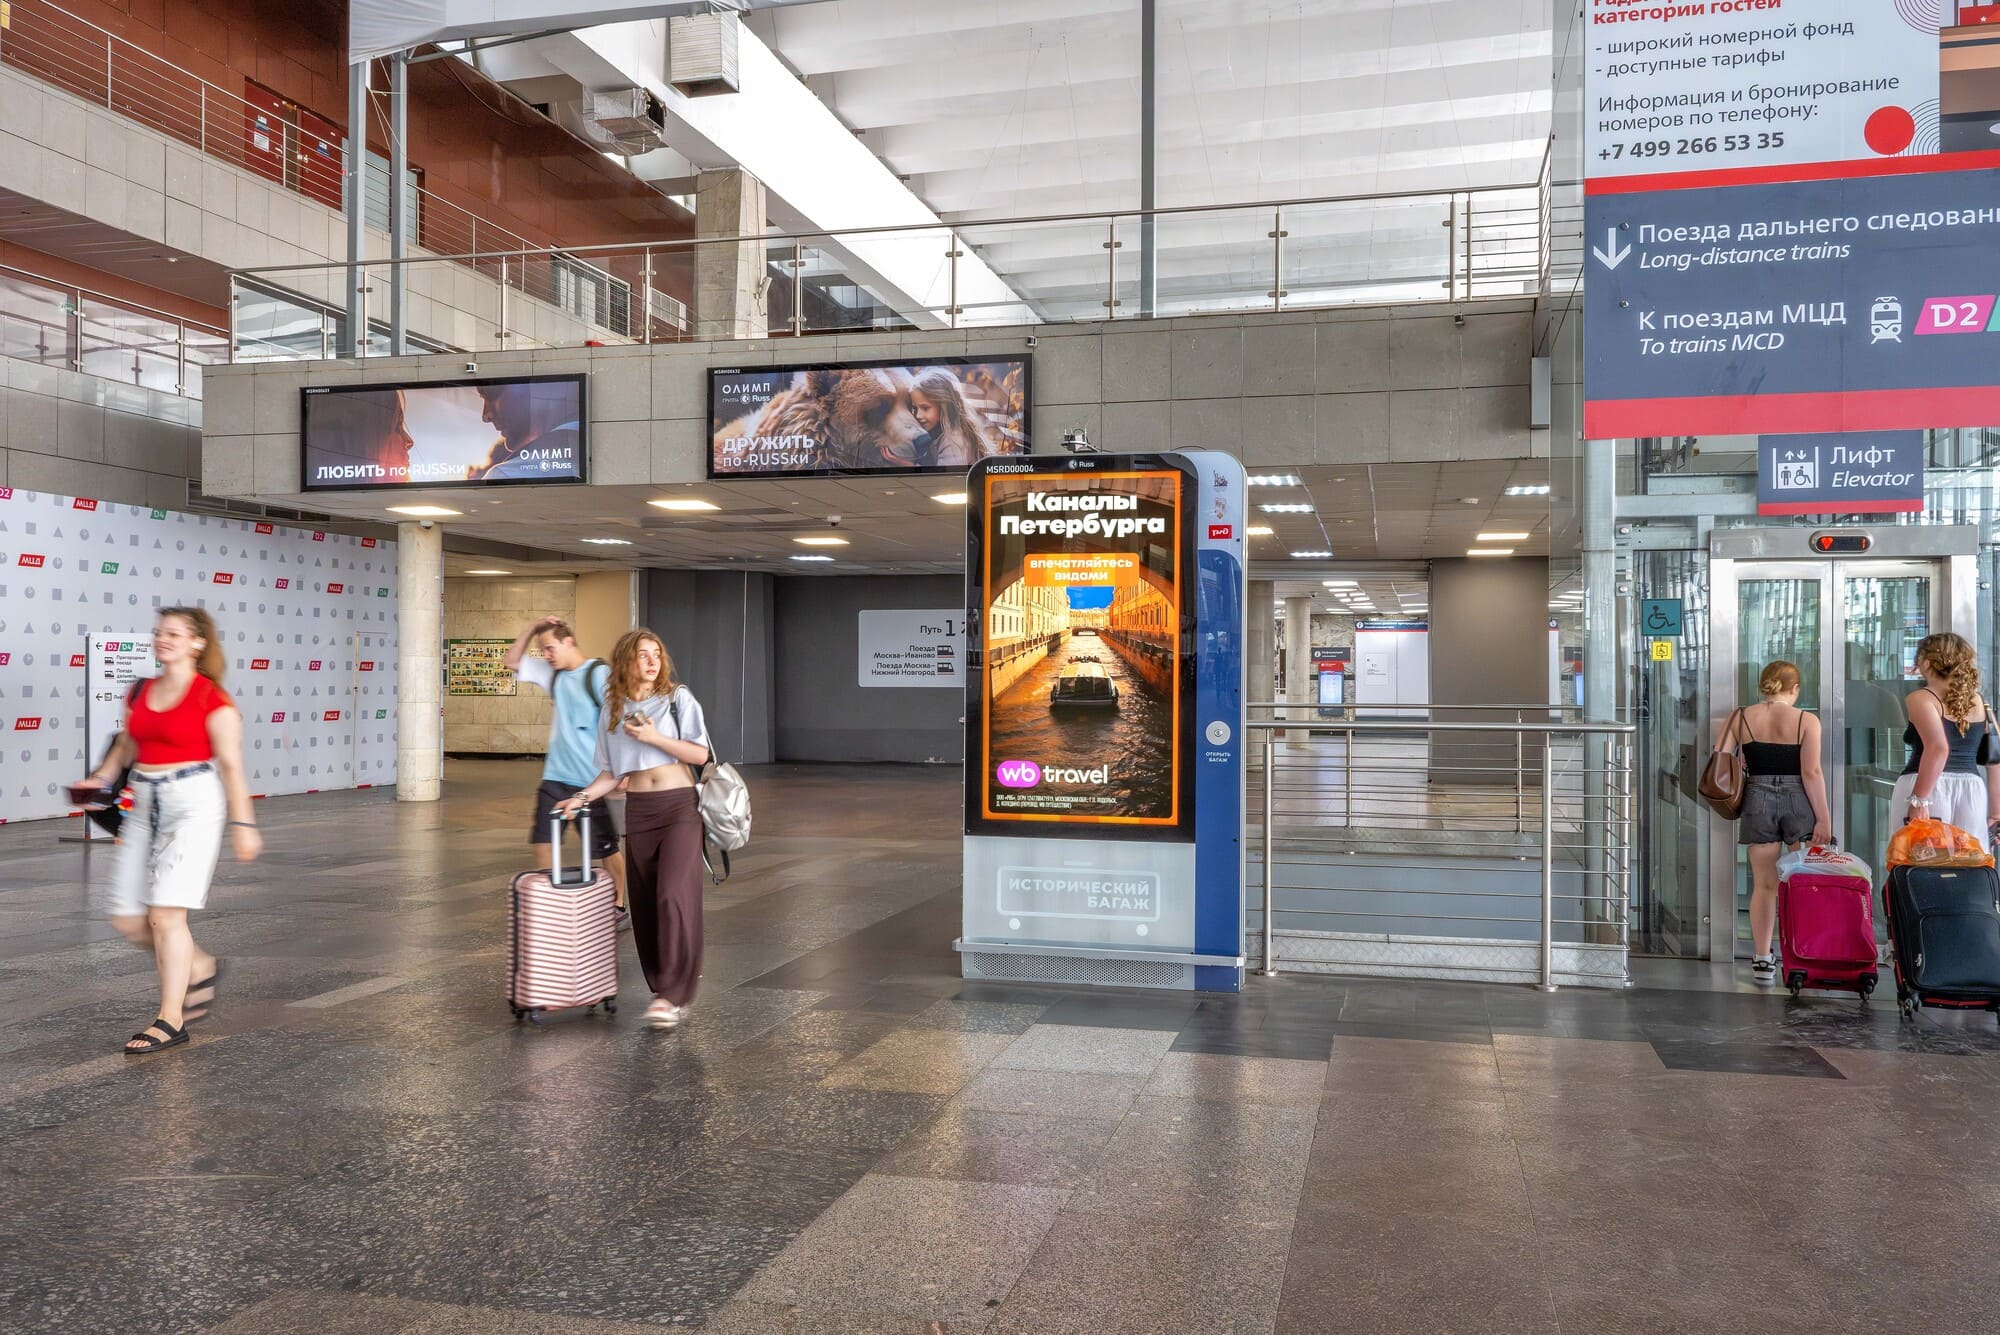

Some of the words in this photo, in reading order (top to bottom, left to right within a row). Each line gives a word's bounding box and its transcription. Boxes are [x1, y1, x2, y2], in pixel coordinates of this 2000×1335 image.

[1594, 3, 1705, 24] категории
[1608, 32, 1693, 55] широкий
[1699, 24, 1797, 46] номерной
[1803, 22, 1855, 40] фонд
[1606, 55, 1707, 77] доступные
[1712, 48, 1786, 72] тарифы
[1599, 89, 1725, 115] Информация
[1731, 90, 1743, 101] и
[1748, 76, 1900, 104] бронирование
[1599, 114, 1684, 134] номеров
[1690, 112, 1713, 126] по
[1718, 103, 1819, 124] телефону:
[1598, 144, 1624, 160] +7
[1630, 140, 1670, 158] 499
[1676, 137, 1717, 154] 266
[1724, 135, 1750, 151] 53
[1757, 132, 1785, 149] 35
[1639, 224, 1731, 244] Поезда
[1737, 215, 1859, 241] дальнего
[1867, 207, 2000, 231] следован
[1639, 246, 1786, 271] Long-distance
[1790, 242, 1850, 261] trains
[1639, 311, 1655, 330] К
[1664, 307, 1774, 329] поездам
[1782, 302, 1846, 326] МЦД
[1930, 302, 1978, 328] D2
[1640, 337, 1664, 355] To
[1669, 335, 1726, 354] trains
[1731, 332, 1785, 351] MCD
[722, 383, 770, 394] ОЛИМП
[723, 434, 815, 452] ДРУЖИТЬ
[520, 448, 572, 460] ОЛИМП
[723, 452, 809, 468] по-RUSSки
[1830, 446, 1896, 467] Лифт
[317, 464, 385, 479] ЛЮБИТЬ
[552, 461, 572, 469] Russ
[986, 464, 1034, 474] MSRD00004
[1079, 461, 1095, 469] Russ
[1831, 470, 1914, 488] Elevator
[1027, 492, 1137, 512] Каналы
[1000, 513, 1165, 538] Петербурга
[104, 563, 117, 572] D4
[1030, 558, 1134, 569] впечатляйтесь
[1054, 572, 1108, 582] видами
[920, 625, 942, 635] Путь
[274, 713, 283, 721] D2
[1001, 763, 1036, 782] wb
[1043, 764, 1108, 784] travel
[1008, 878, 1149, 896] ИСТОРИЧЕСКИЙ
[1087, 896, 1149, 910] БАГАЖ
